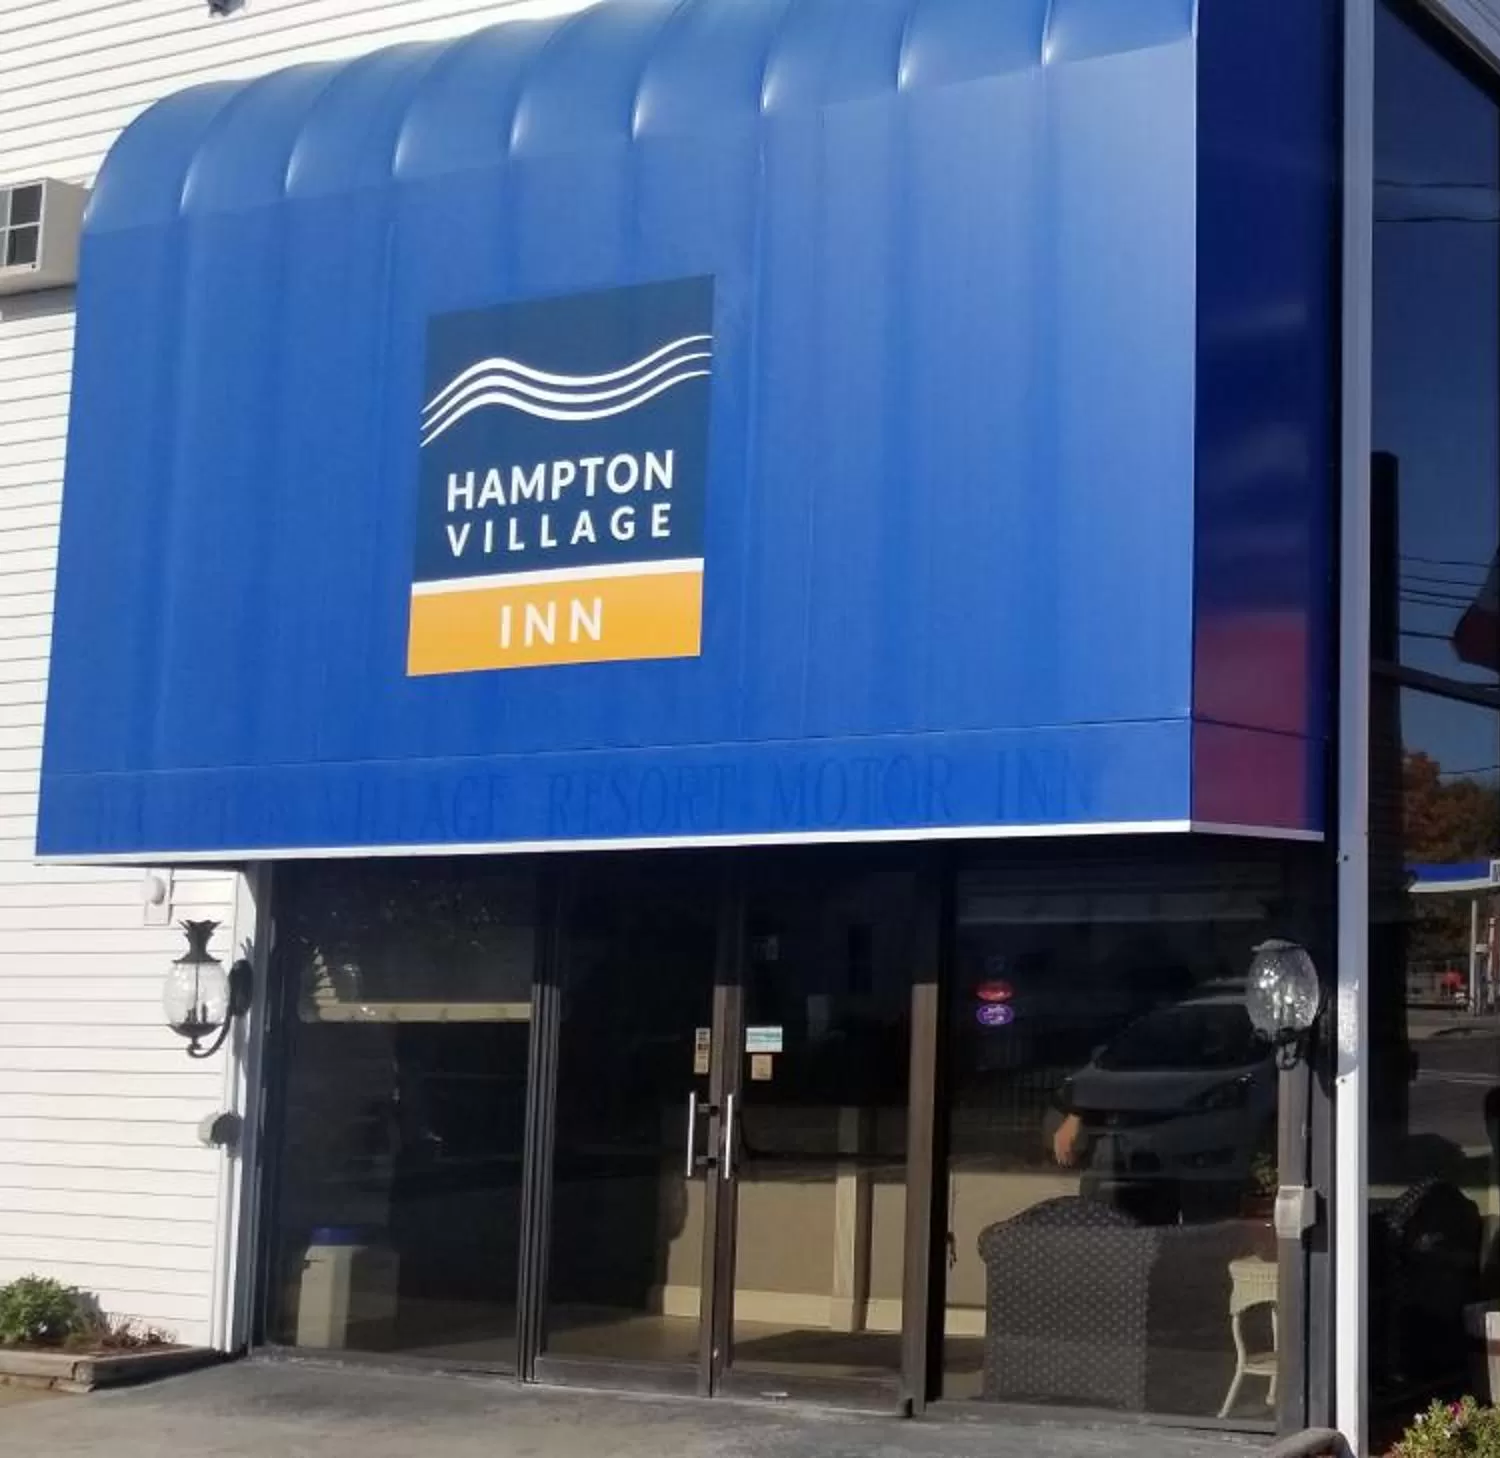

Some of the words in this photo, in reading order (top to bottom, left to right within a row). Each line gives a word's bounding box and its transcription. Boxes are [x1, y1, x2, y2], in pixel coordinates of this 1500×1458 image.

[447, 449, 674, 513] HAMPTON
[445, 503, 672, 557] VILLAGE
[500, 596, 604, 650] INN
